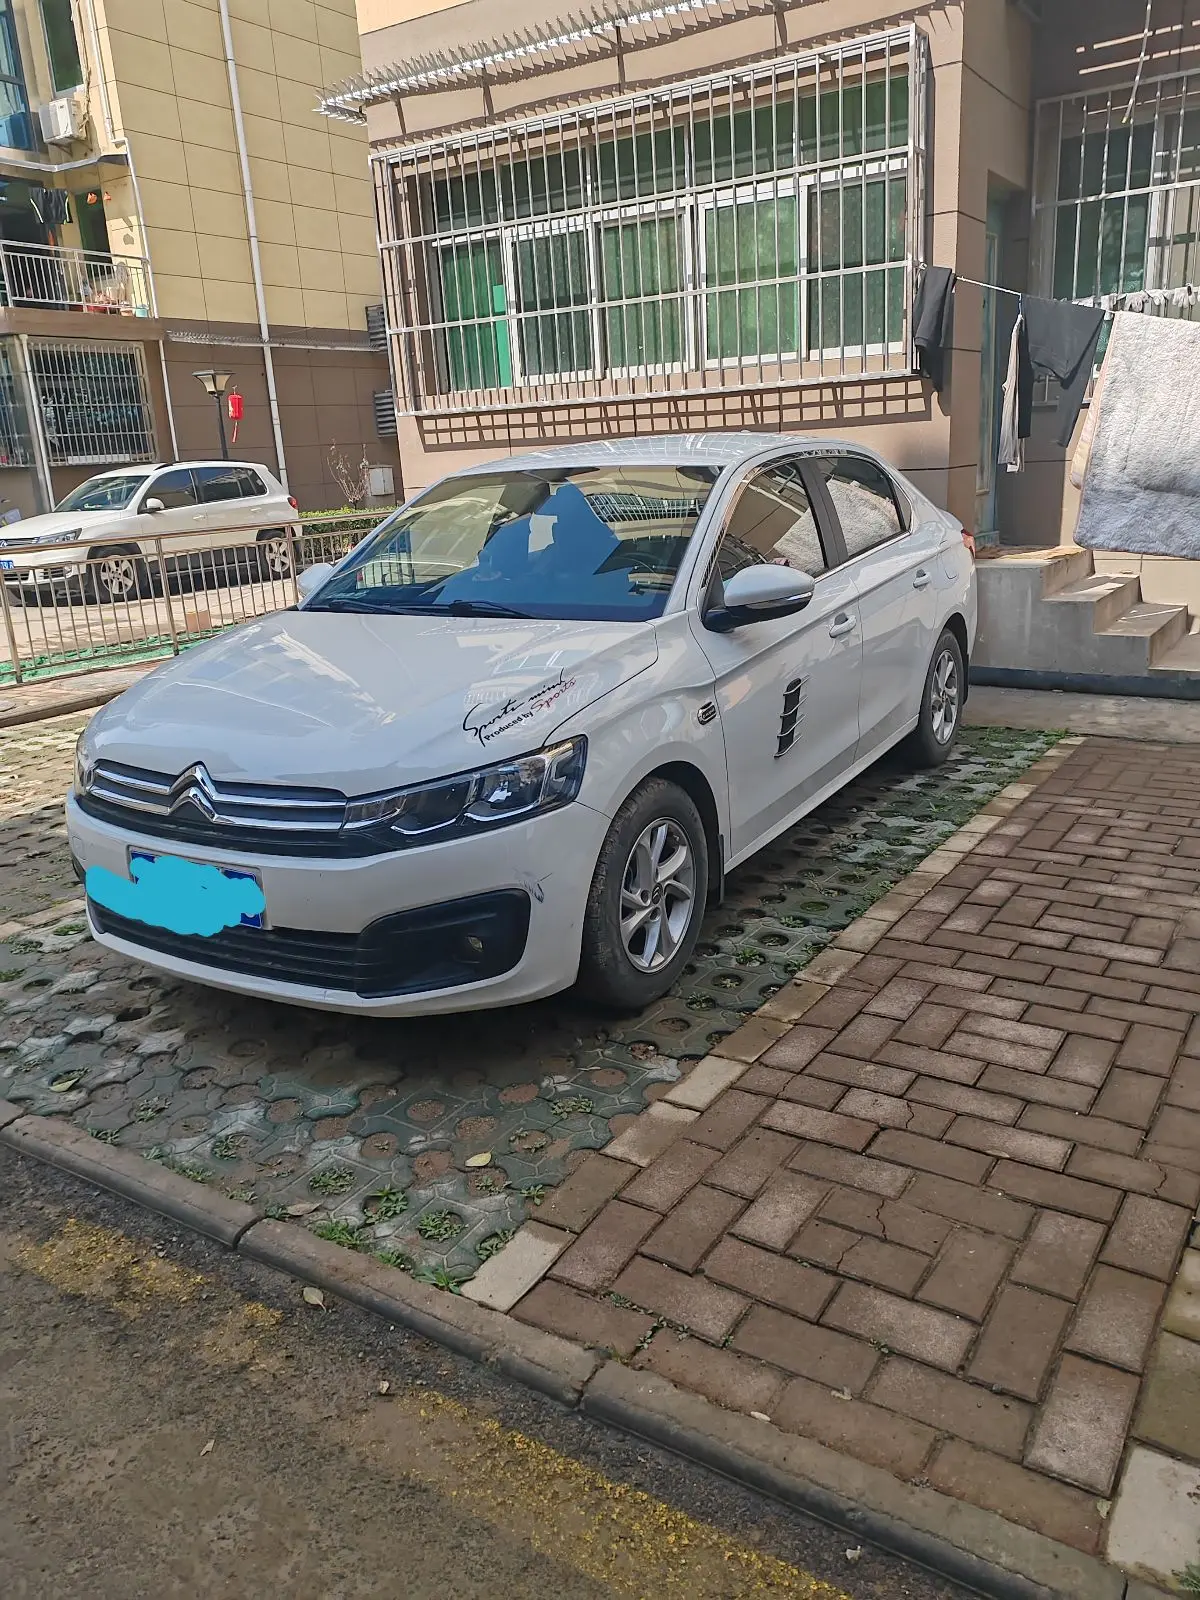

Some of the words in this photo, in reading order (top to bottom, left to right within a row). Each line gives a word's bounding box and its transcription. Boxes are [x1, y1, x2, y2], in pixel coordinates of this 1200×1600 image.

[484, 716, 523, 741] Produced
[522, 711, 534, 719] by
[530, 677, 577, 712] Sports
